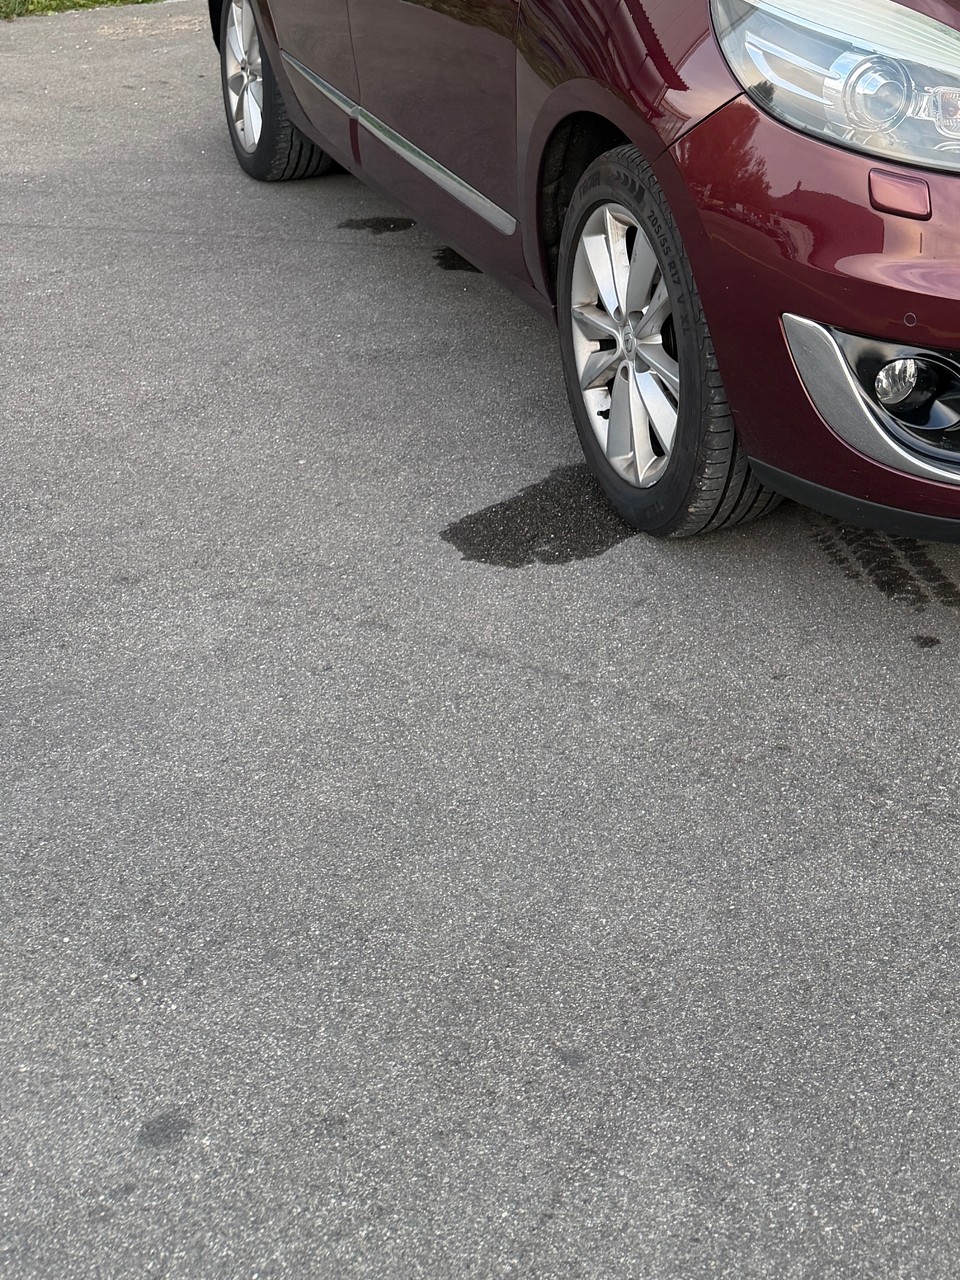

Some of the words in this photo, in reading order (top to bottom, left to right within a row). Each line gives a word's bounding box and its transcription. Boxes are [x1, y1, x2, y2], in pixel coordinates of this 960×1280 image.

[647, 210, 671, 256] 205/55
[667, 260, 681, 286] R17
[680, 313, 691, 336] XL
